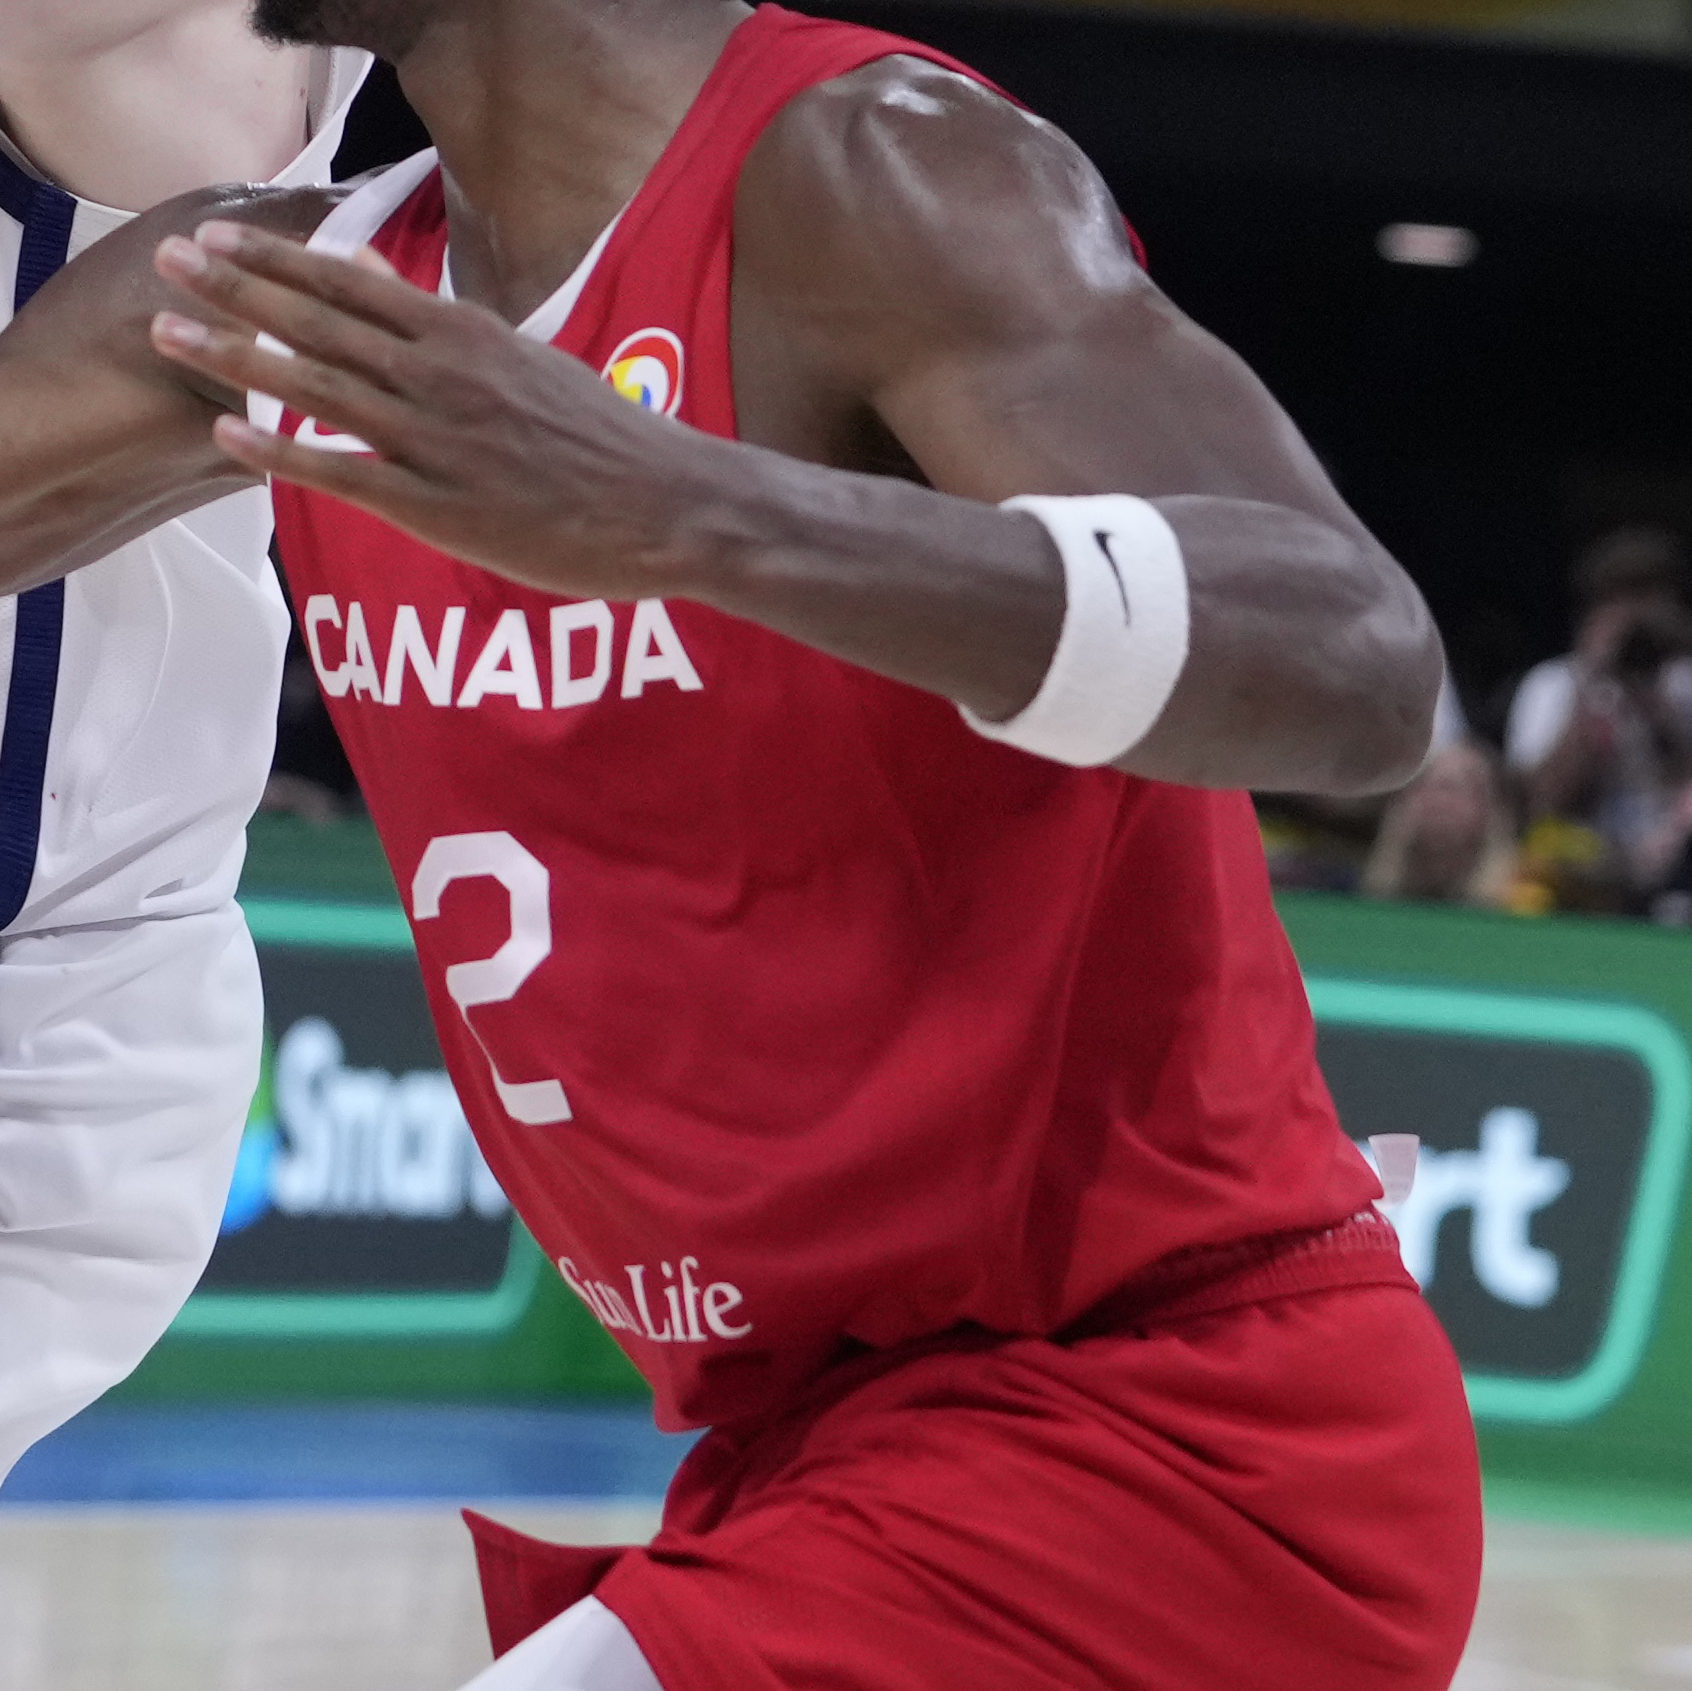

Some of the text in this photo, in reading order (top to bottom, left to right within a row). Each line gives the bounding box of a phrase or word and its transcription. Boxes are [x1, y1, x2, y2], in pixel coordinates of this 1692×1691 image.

[304, 593, 704, 710] CANADA
[412, 830, 573, 1126] 2
[623, 1255, 754, 1343] Life
